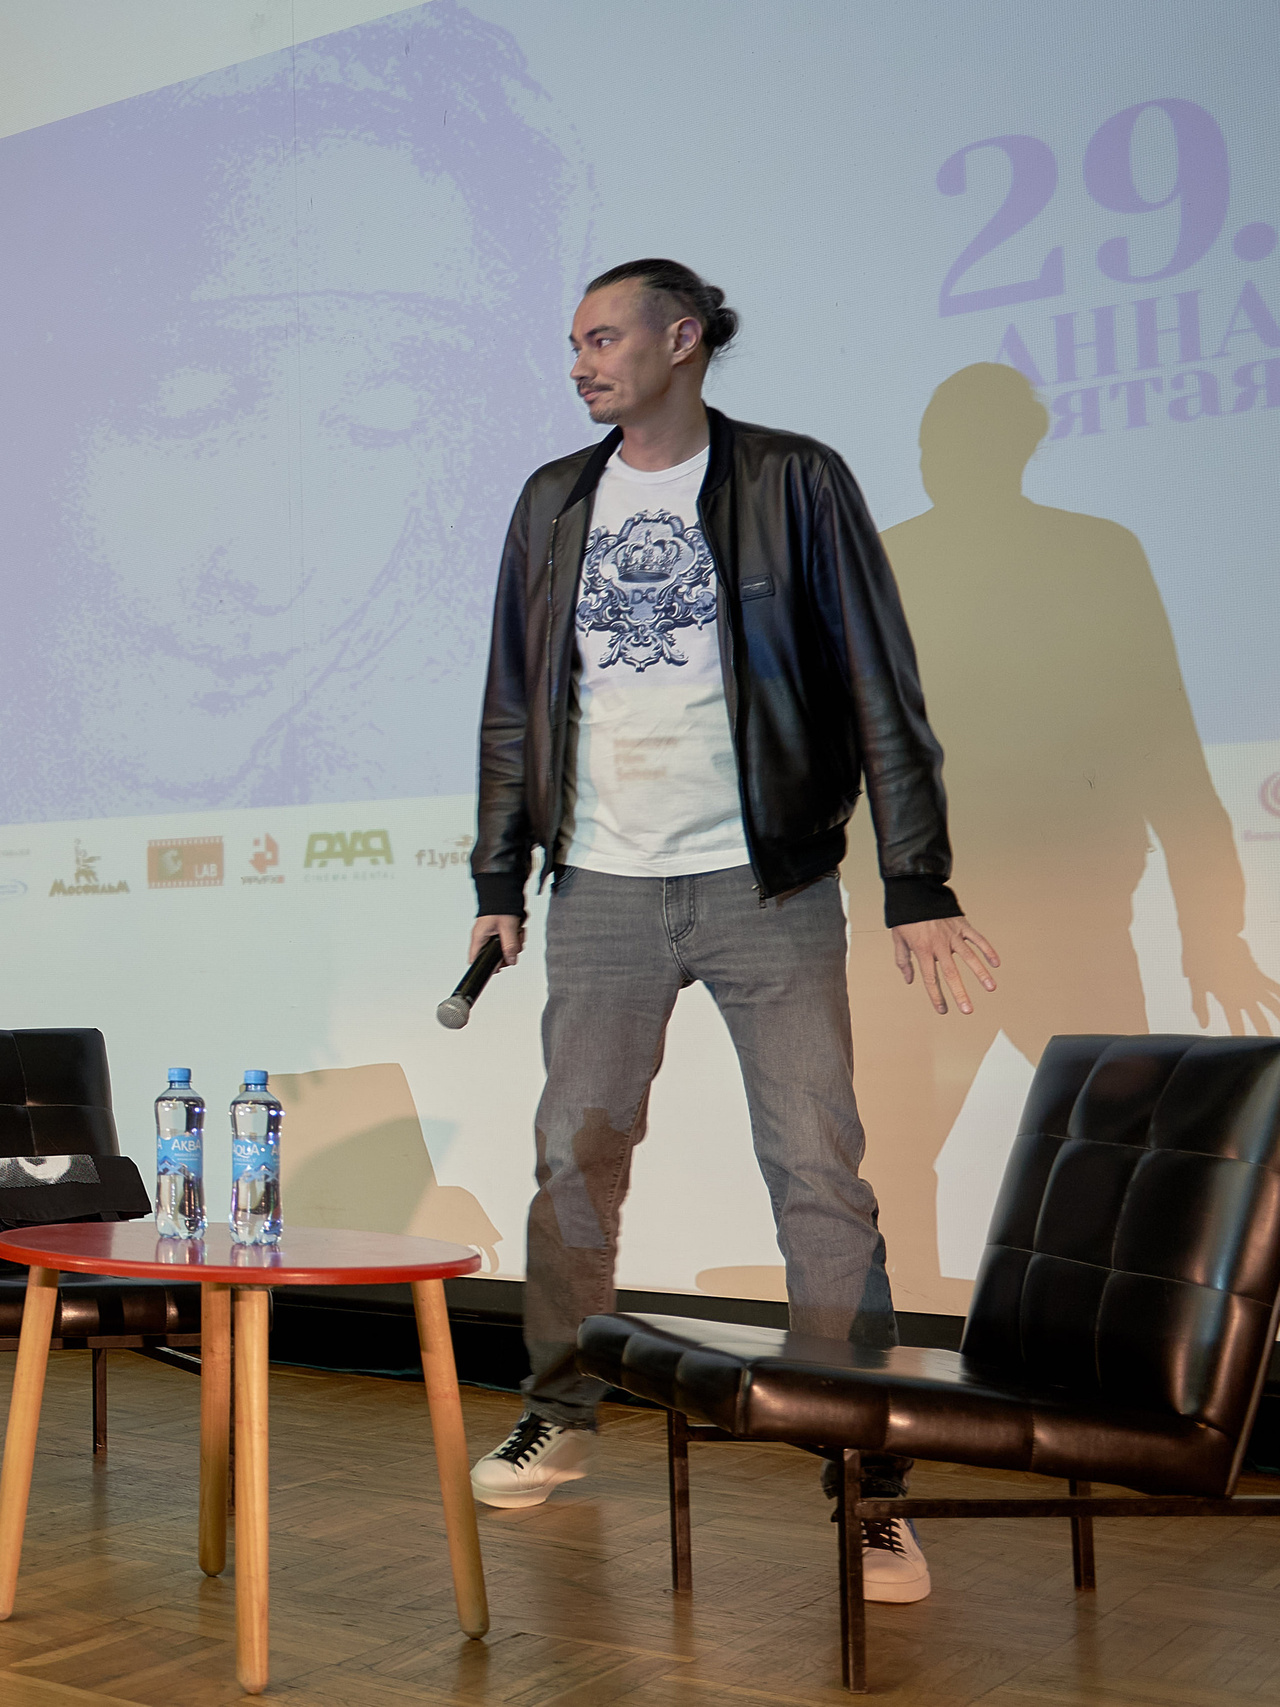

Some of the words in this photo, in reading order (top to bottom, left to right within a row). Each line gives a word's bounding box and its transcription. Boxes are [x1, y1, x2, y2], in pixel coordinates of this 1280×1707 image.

[936, 98, 1278, 318] 29.
[996, 279, 1280, 388] АННА
[1051, 358, 1280, 440] ятая
[193, 863, 218, 879] LAB
